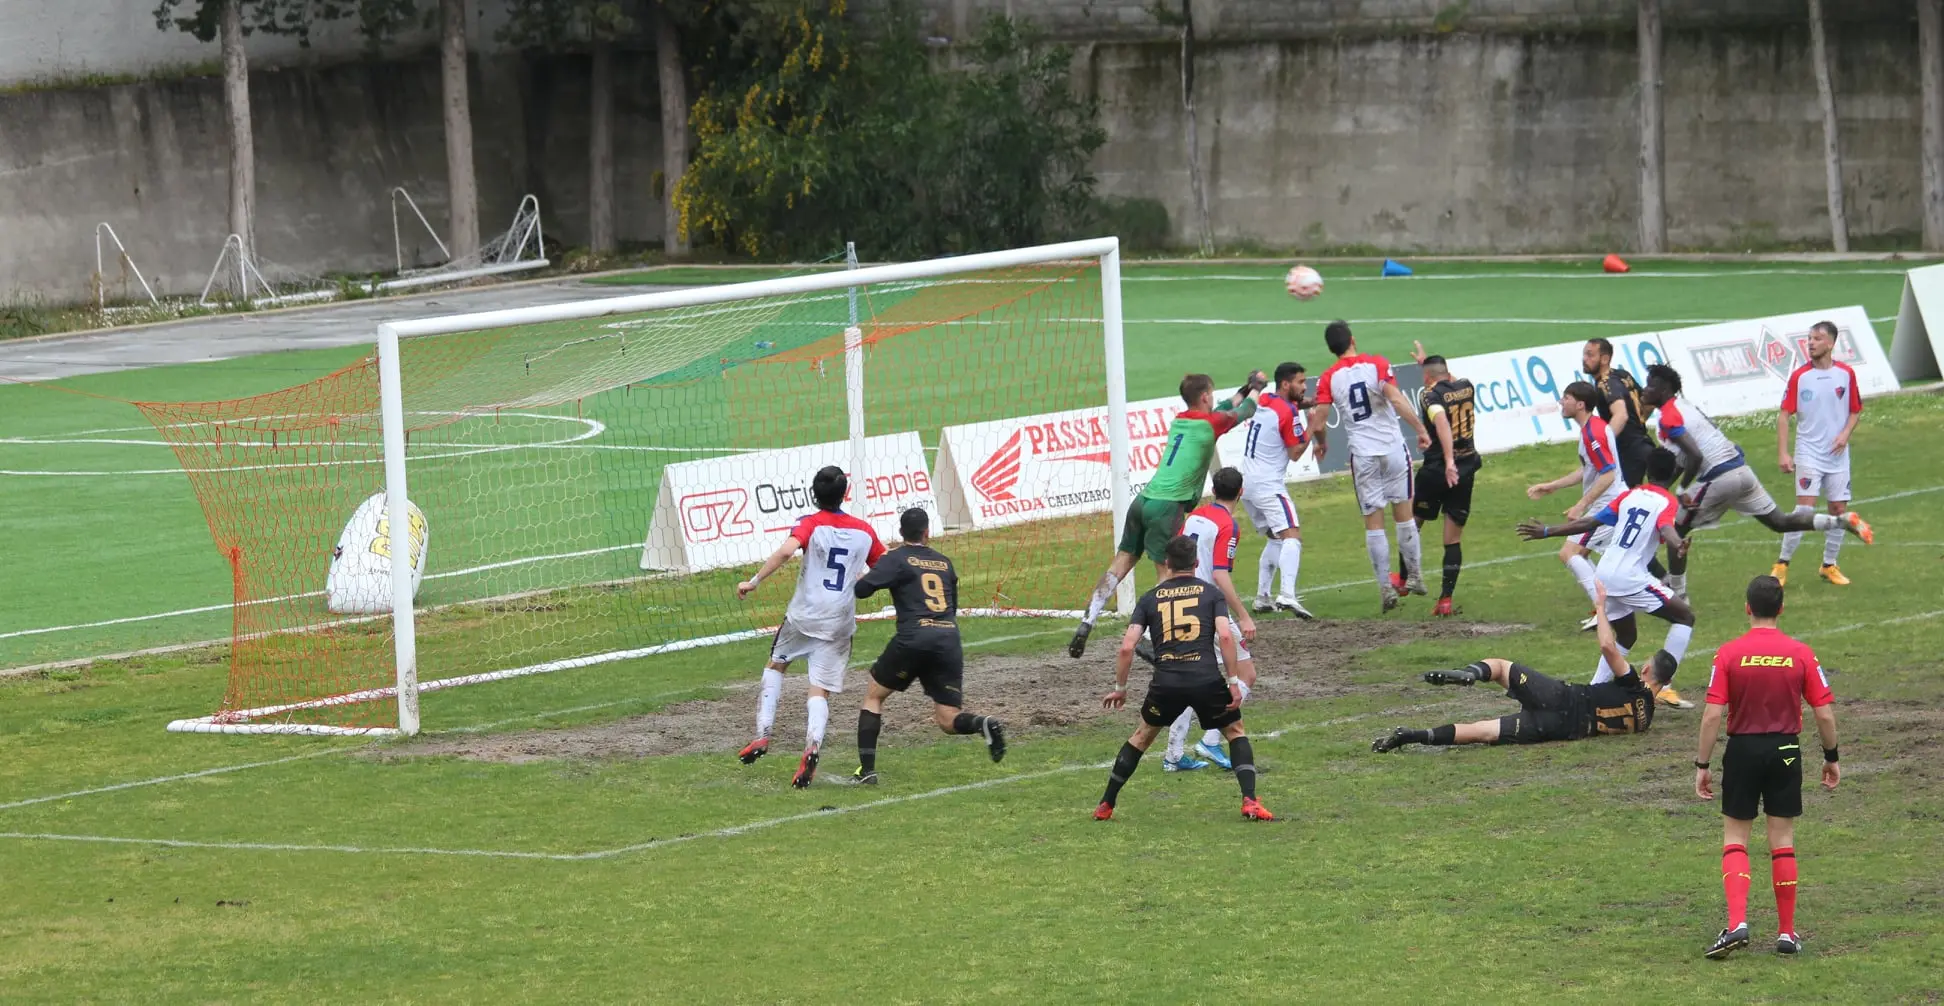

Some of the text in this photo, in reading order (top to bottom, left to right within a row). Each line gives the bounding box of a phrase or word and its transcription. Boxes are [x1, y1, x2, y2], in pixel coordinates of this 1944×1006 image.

[1349, 381, 1373, 422] 9
[1449, 401, 1474, 441] 10
[1167, 433, 1184, 467] 1
[1244, 420, 1262, 459] 11
[981, 496, 1046, 518] HONDA
[1047, 487, 1111, 509] CATANZARO
[1619, 507, 1650, 549] 18
[823, 547, 848, 592] 5
[920, 572, 948, 613] 9
[1157, 597, 1201, 643] 15
[1741, 655, 1793, 668] LEGEA
